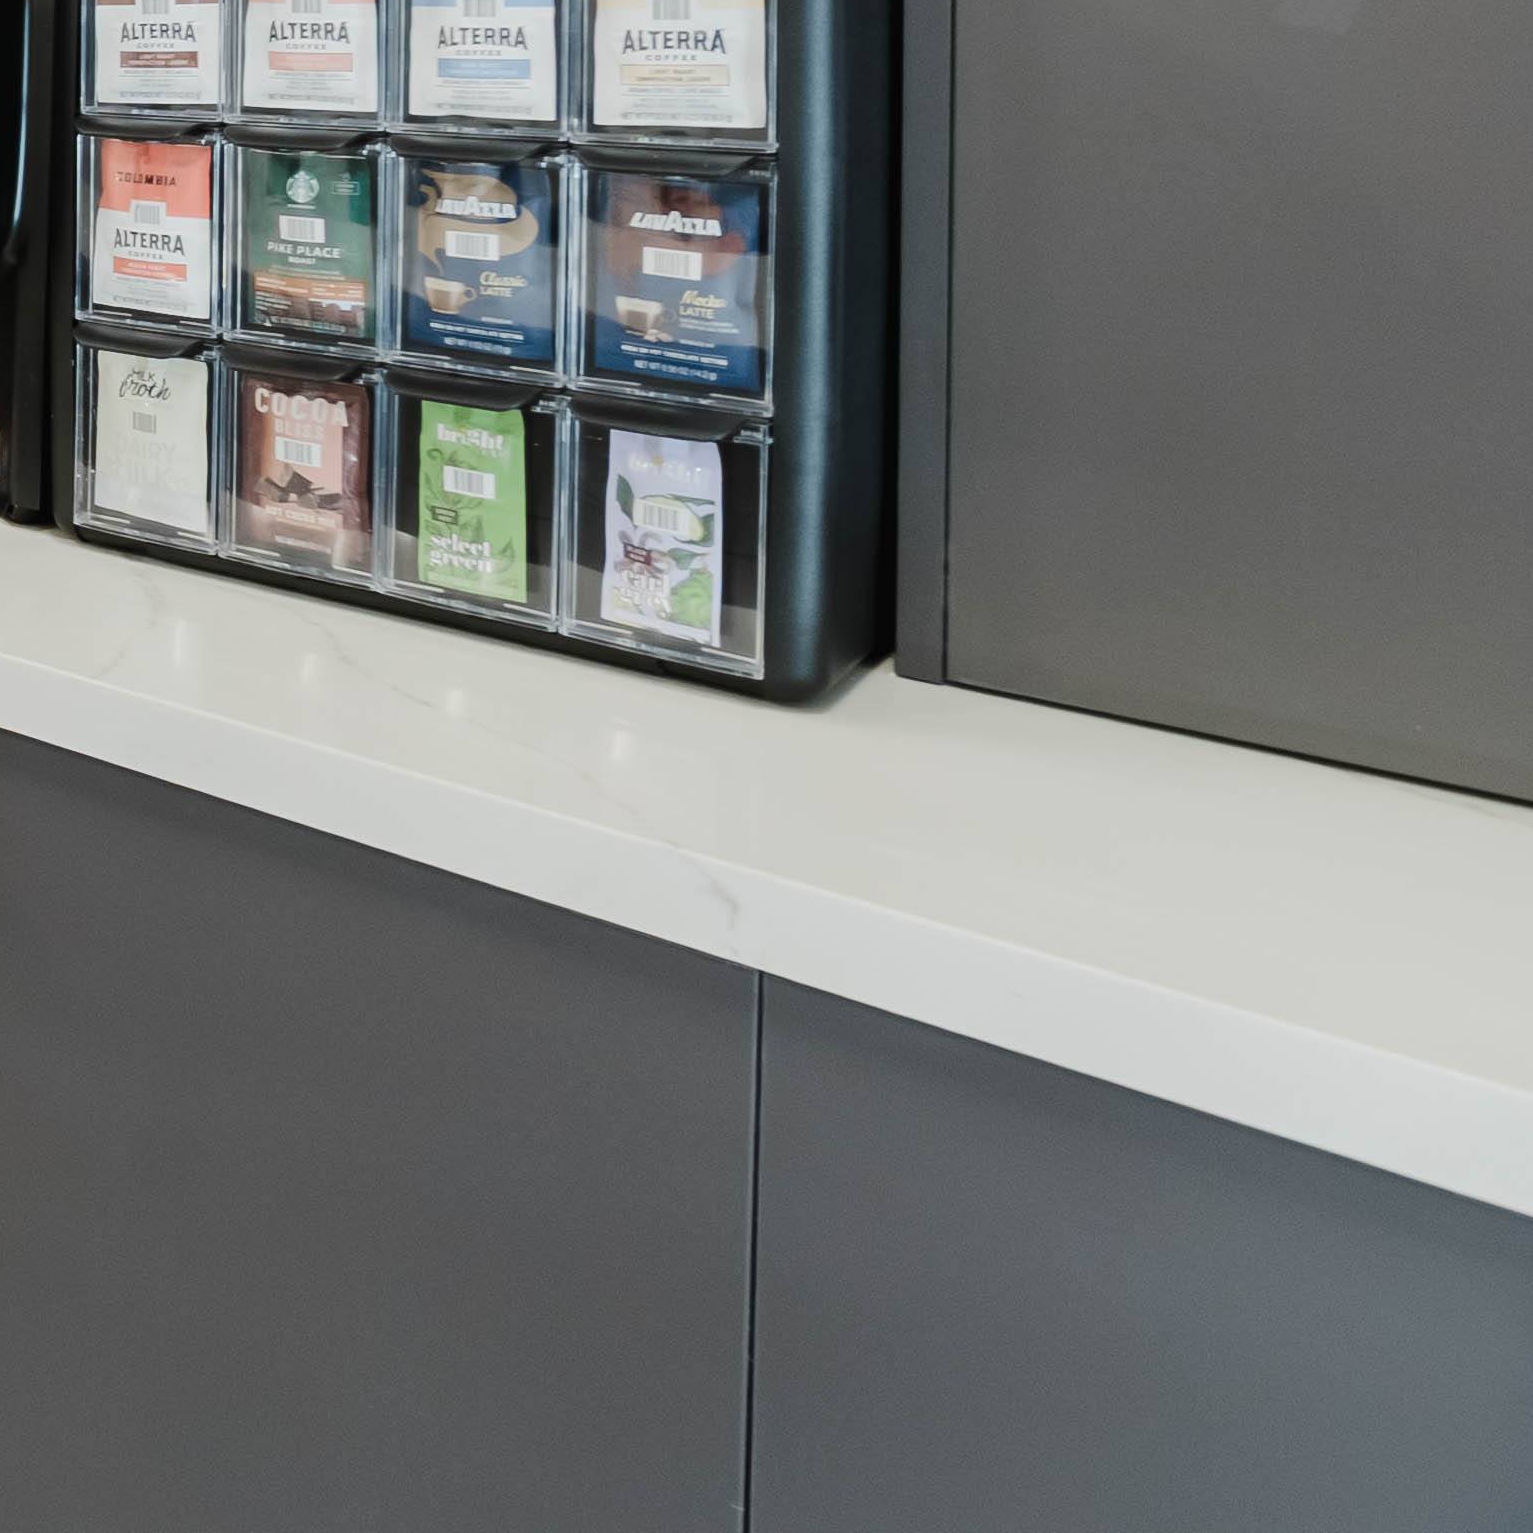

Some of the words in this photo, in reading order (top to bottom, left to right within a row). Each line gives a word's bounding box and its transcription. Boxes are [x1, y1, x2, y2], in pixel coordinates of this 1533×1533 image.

[120, 21, 197, 43] ALTERRA
[269, 20, 350, 44] ALTERRA
[437, 25, 529, 50] ALTERRA
[622, 29, 726, 55] ALTERRA
[116, 171, 177, 186] COLOMBIA
[435, 196, 518, 219] LAVAZZA
[629, 211, 723, 237] LAVAZZA
[114, 228, 186, 255] ALTERRA
[267, 241, 294, 254] PIKE
[296, 245, 341, 259] PLACE
[679, 306, 716, 318] LATTE
[119, 374, 172, 401] froth
[254, 386, 349, 427] COCOA
[429, 533, 491, 557] select
[429, 549, 492, 574] green
